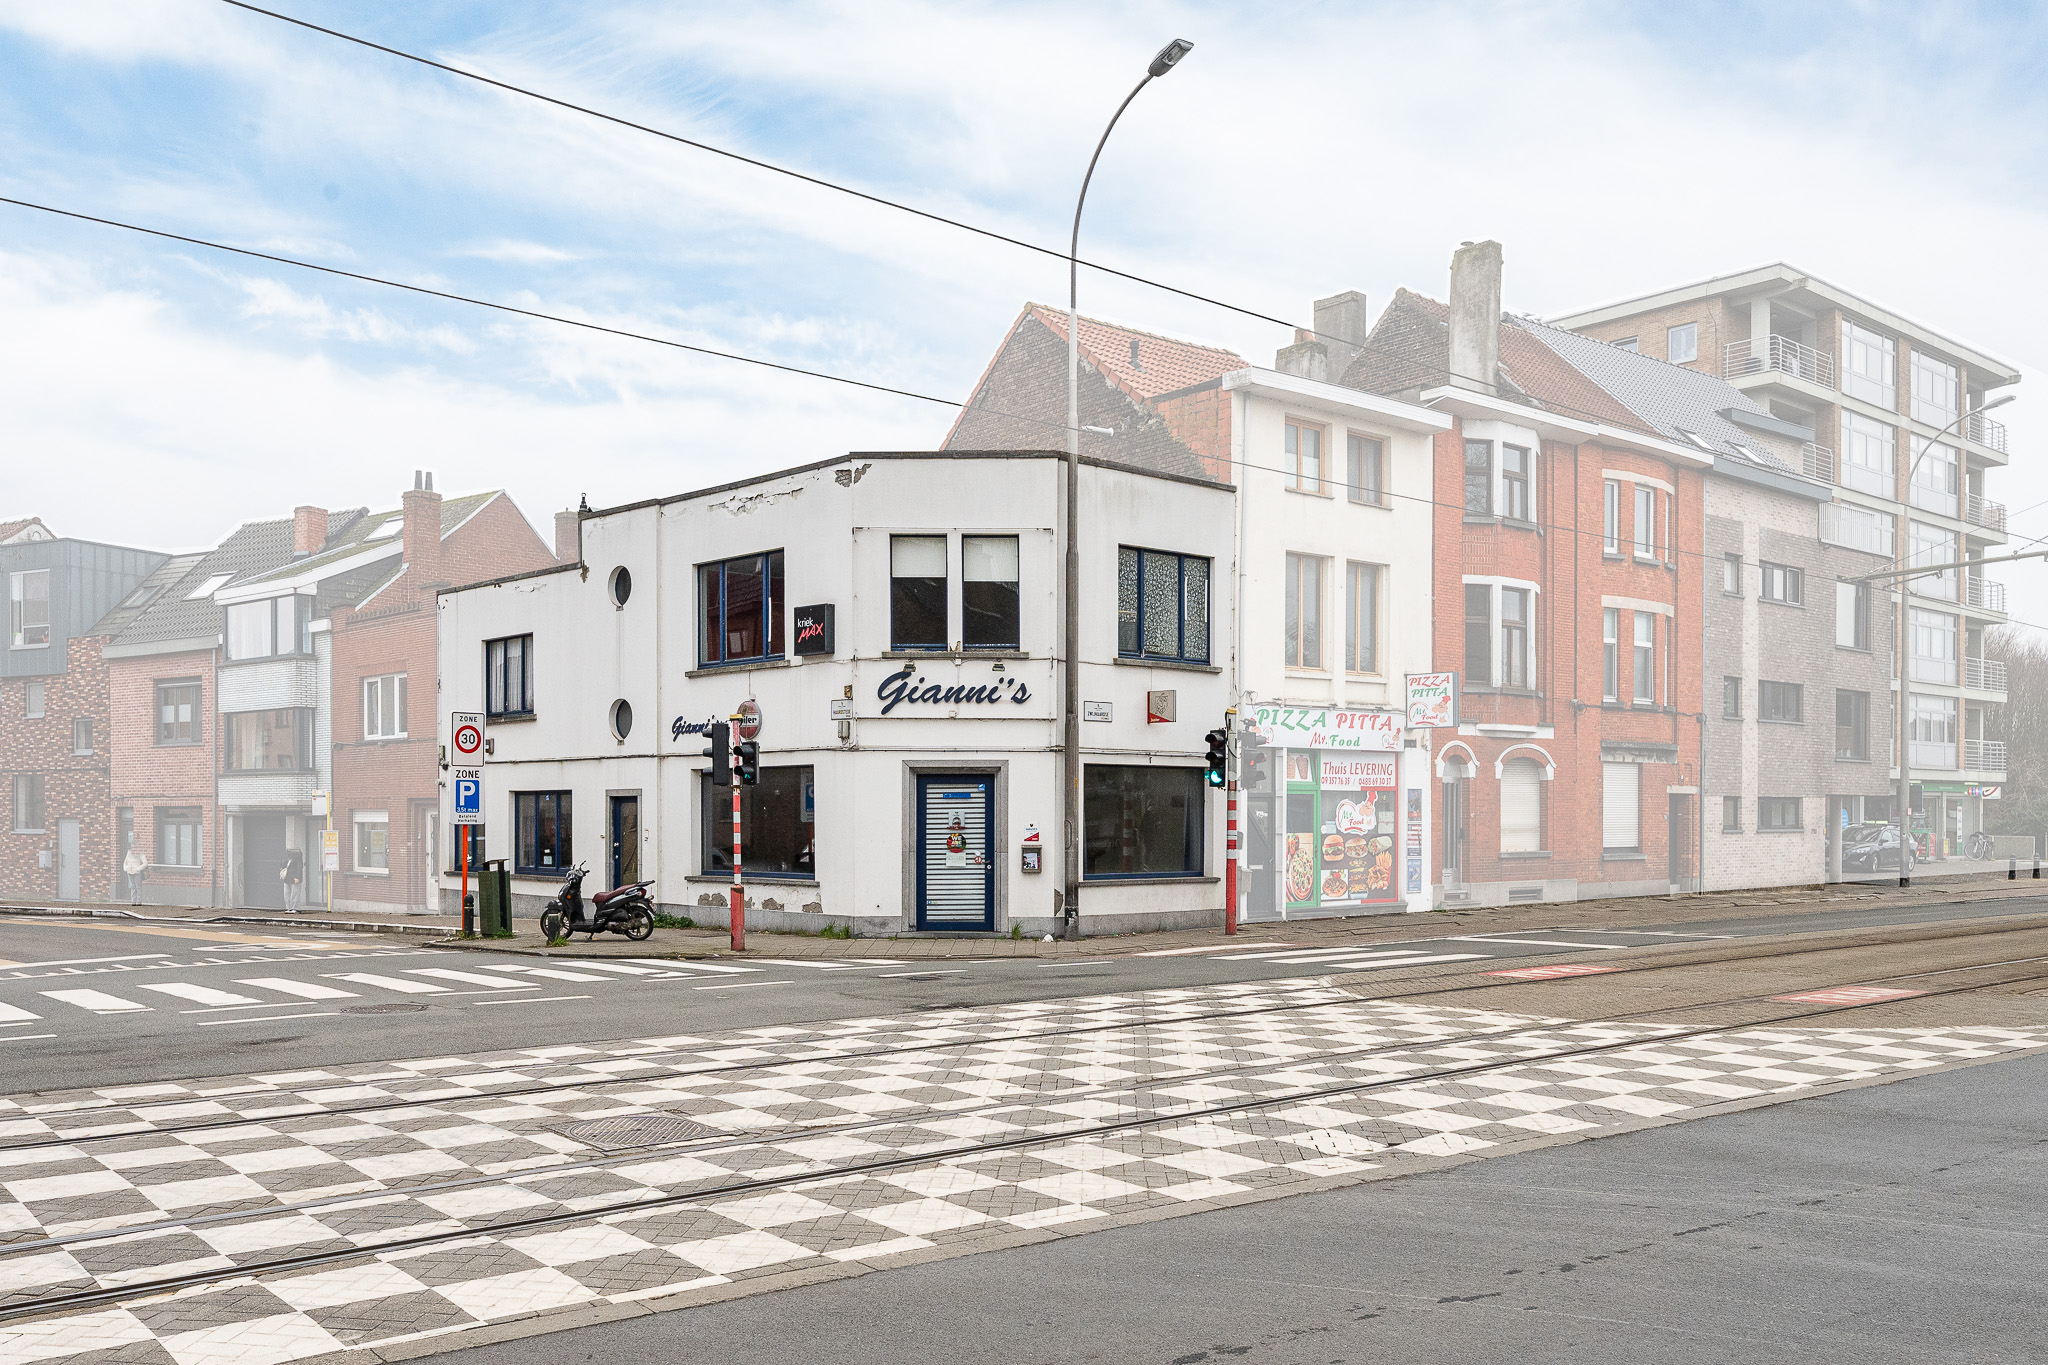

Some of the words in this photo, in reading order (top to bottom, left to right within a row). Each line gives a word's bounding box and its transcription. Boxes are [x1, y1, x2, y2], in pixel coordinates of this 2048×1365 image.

[797, 617, 814, 628] kriek
[797, 622, 824, 643] MAX
[1408, 675, 1450, 687] PIZZA
[877, 670, 1032, 716] Gianni's
[1411, 687, 1447, 698] PITTA
[1256, 708, 1326, 731] PIZZA
[1335, 712, 1392, 732] PITTA
[671, 714, 719, 742] Gianni'
[460, 733, 476, 745] 30
[1309, 732, 1328, 747] Mr.
[1329, 734, 1361, 747] Food
[455, 769, 480, 779] ZONE
[1323, 761, 1347, 775] Thuis
[1349, 762, 1393, 776] LEVERING
[1320, 776, 1328, 785] 09
[1329, 777, 1337, 785] 357
[459, 781, 476, 806] P
